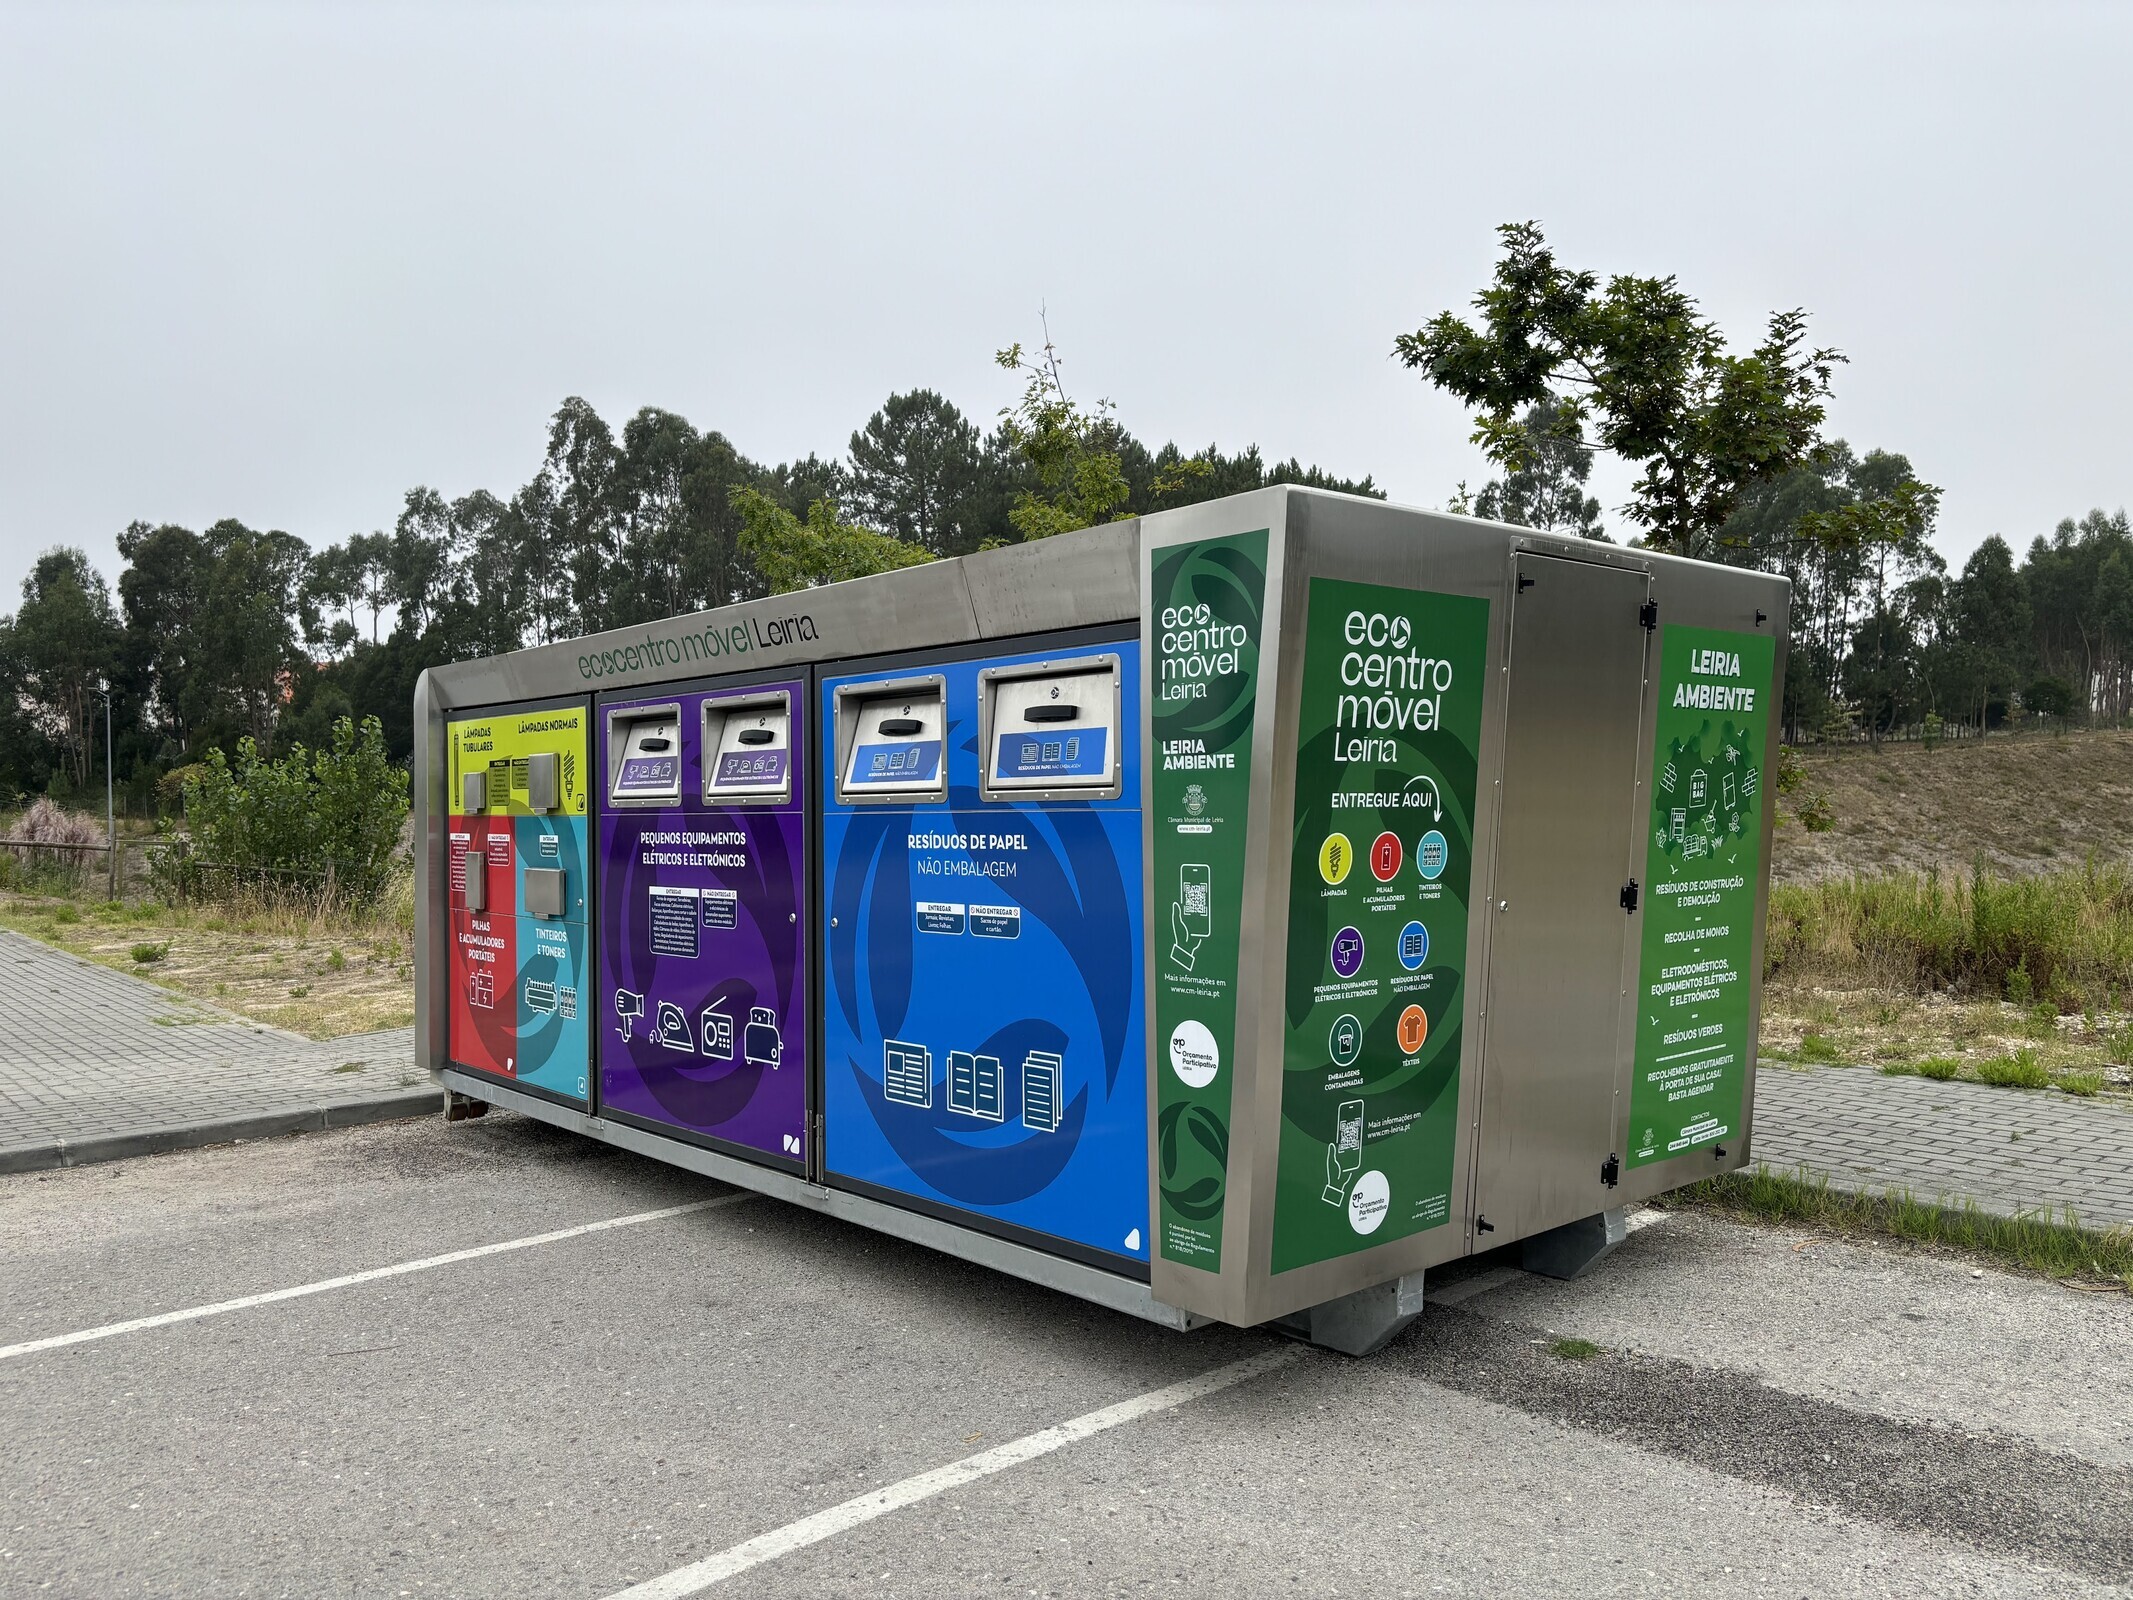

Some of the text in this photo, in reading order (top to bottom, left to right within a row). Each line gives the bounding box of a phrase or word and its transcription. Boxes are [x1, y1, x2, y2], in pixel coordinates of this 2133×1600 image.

[1162, 604, 1210, 628] eco
[1162, 620, 1246, 654] centro
[1344, 610, 1411, 649] eco
[578, 634, 680, 679] ecocentro
[753, 614, 819, 648] Leiria
[1340, 646, 1452, 692] centro
[1690, 648, 1740, 677] LEIRIA
[1162, 682, 1207, 700] Leiria
[1672, 683, 1755, 712] AMBIENTE
[464, 727, 491, 738] LÂMPADAS
[518, 718, 578, 734] LÂMPADAS NORMAIS
[463, 742, 493, 752] TUBULARES
[1162, 739, 1205, 754] LEIRIA
[1334, 732, 1398, 762] Leiria
[1163, 754, 1235, 770] AMBIENTE
[1693, 782, 1704, 790] BIG
[1693, 790, 1704, 798] BAG
[1331, 792, 1432, 808] ENTREGUE AQUI
[641, 832, 746, 847] PEQUENOS EQUIPAMENTOS
[908, 830, 1027, 850] RESÍDUOS DE PAPEL
[643, 849, 746, 867] ELÉTRICOS E ELETRÓNICOS
[918, 857, 1017, 877] NÃO EMBALAGEM
[1656, 875, 1744, 895] RESÍDUOS DE CONSTRUÇÃO
[1366, 894, 1405, 903] ACUMULADORES
[1678, 891, 1720, 907] E DEMOLIÇÃO
[1371, 904, 1396, 912] PORTÁTEIS
[472, 920, 490, 931] PILHAS
[459, 933, 505, 949] E ACUMULADORES
[536, 928, 567, 942] TINTEIROS
[1664, 926, 1729, 943] RECOLHA DE MONOS
[469, 948, 495, 962] PORTÁTEIS
[538, 944, 566, 958] E TONERS
[1662, 959, 1729, 978] ELETRODOMÉSTICOS,
[1164, 973, 1178, 981] Mais
[1179, 974, 1215, 986] informações
[1314, 980, 1378, 993] PEQUENOS EQUIPAMENTOS
[1390, 975, 1413, 984] RESÍDUOS
[1651, 971, 1737, 996] EQUIPAMENTOS ELÉTRICOS
[1170, 986, 1220, 998] www.cm-leiria.pt
[1314, 992, 1341, 1003] ELÉTRICOS
[1346, 988, 1378, 999] ELETRÓNICOS
[1393, 983, 1430, 993] NÃO EMBALAGEM
[1670, 988, 1720, 1006] E ELETRÓNICOS
[1664, 1024, 1723, 1045] RESÍDUOS VERDES
[1182, 1050, 1212, 1060] Orçamento
[1182, 1058, 1216, 1069] Participativo
[1648, 1054, 1734, 1082] RECOLHEMOS GRATUITAMENTE
[1328, 1069, 1360, 1080] EMBALAGENS
[1659, 1068, 1722, 1092] À PORTA DE SUA CASA!
[1324, 1078, 1364, 1090] CONTAMINADAS
[1668, 1083, 1714, 1102] BASTA AGENDAR
[1367, 1120, 1381, 1129] Mais
[1382, 1113, 1413, 1125] informações
[1367, 1123, 1411, 1138] www.cm-leiria.pt
[1359, 1198, 1384, 1209] Orçamento
[1359, 1204, 1387, 1216] Participativo
